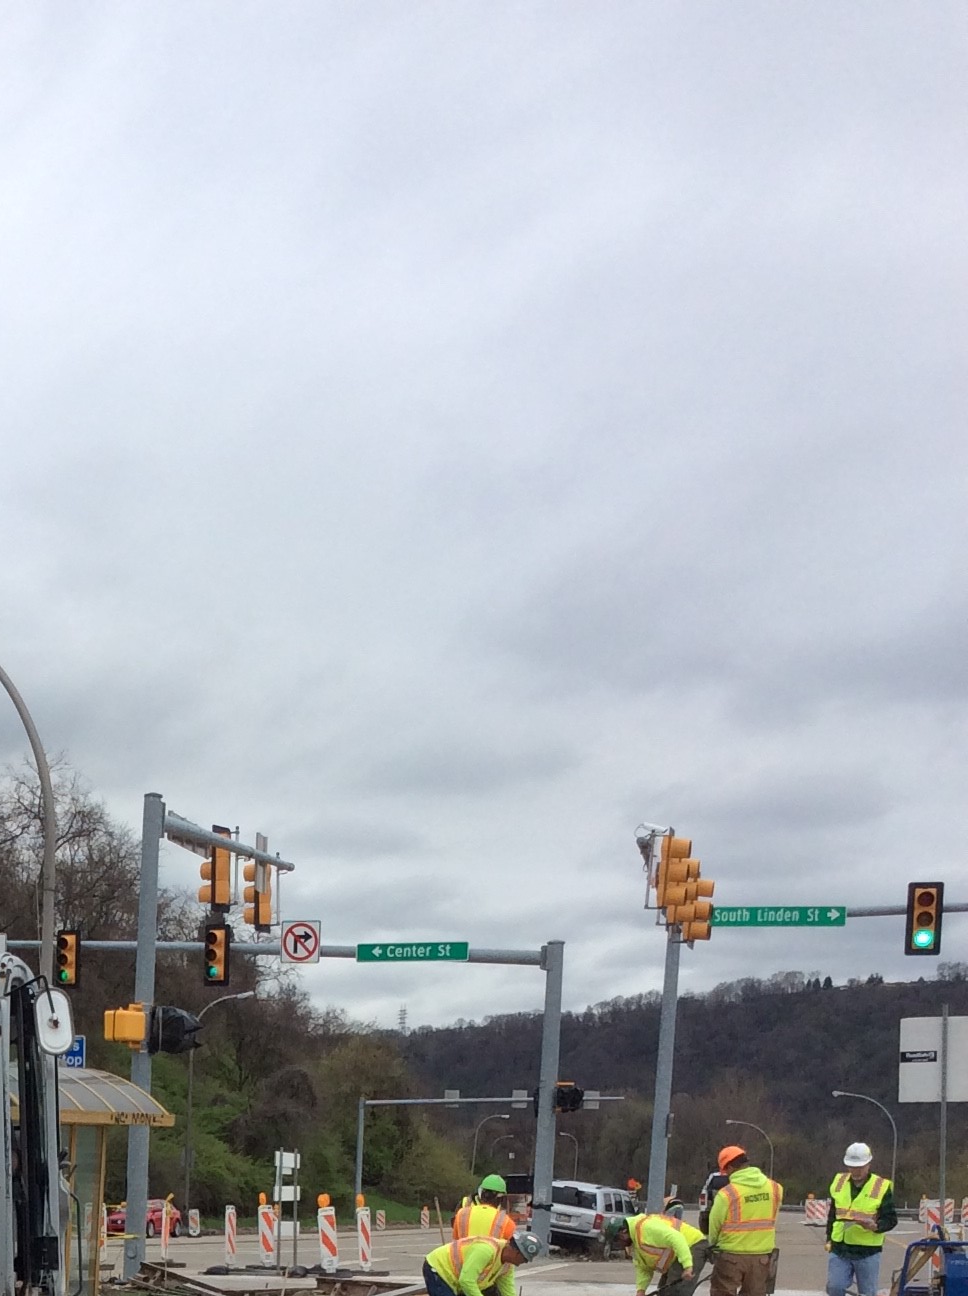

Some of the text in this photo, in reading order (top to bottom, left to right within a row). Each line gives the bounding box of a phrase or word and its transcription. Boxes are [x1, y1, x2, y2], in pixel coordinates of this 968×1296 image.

[714, 908, 820, 922] South Linden St
[386, 944, 451, 958] Center St
